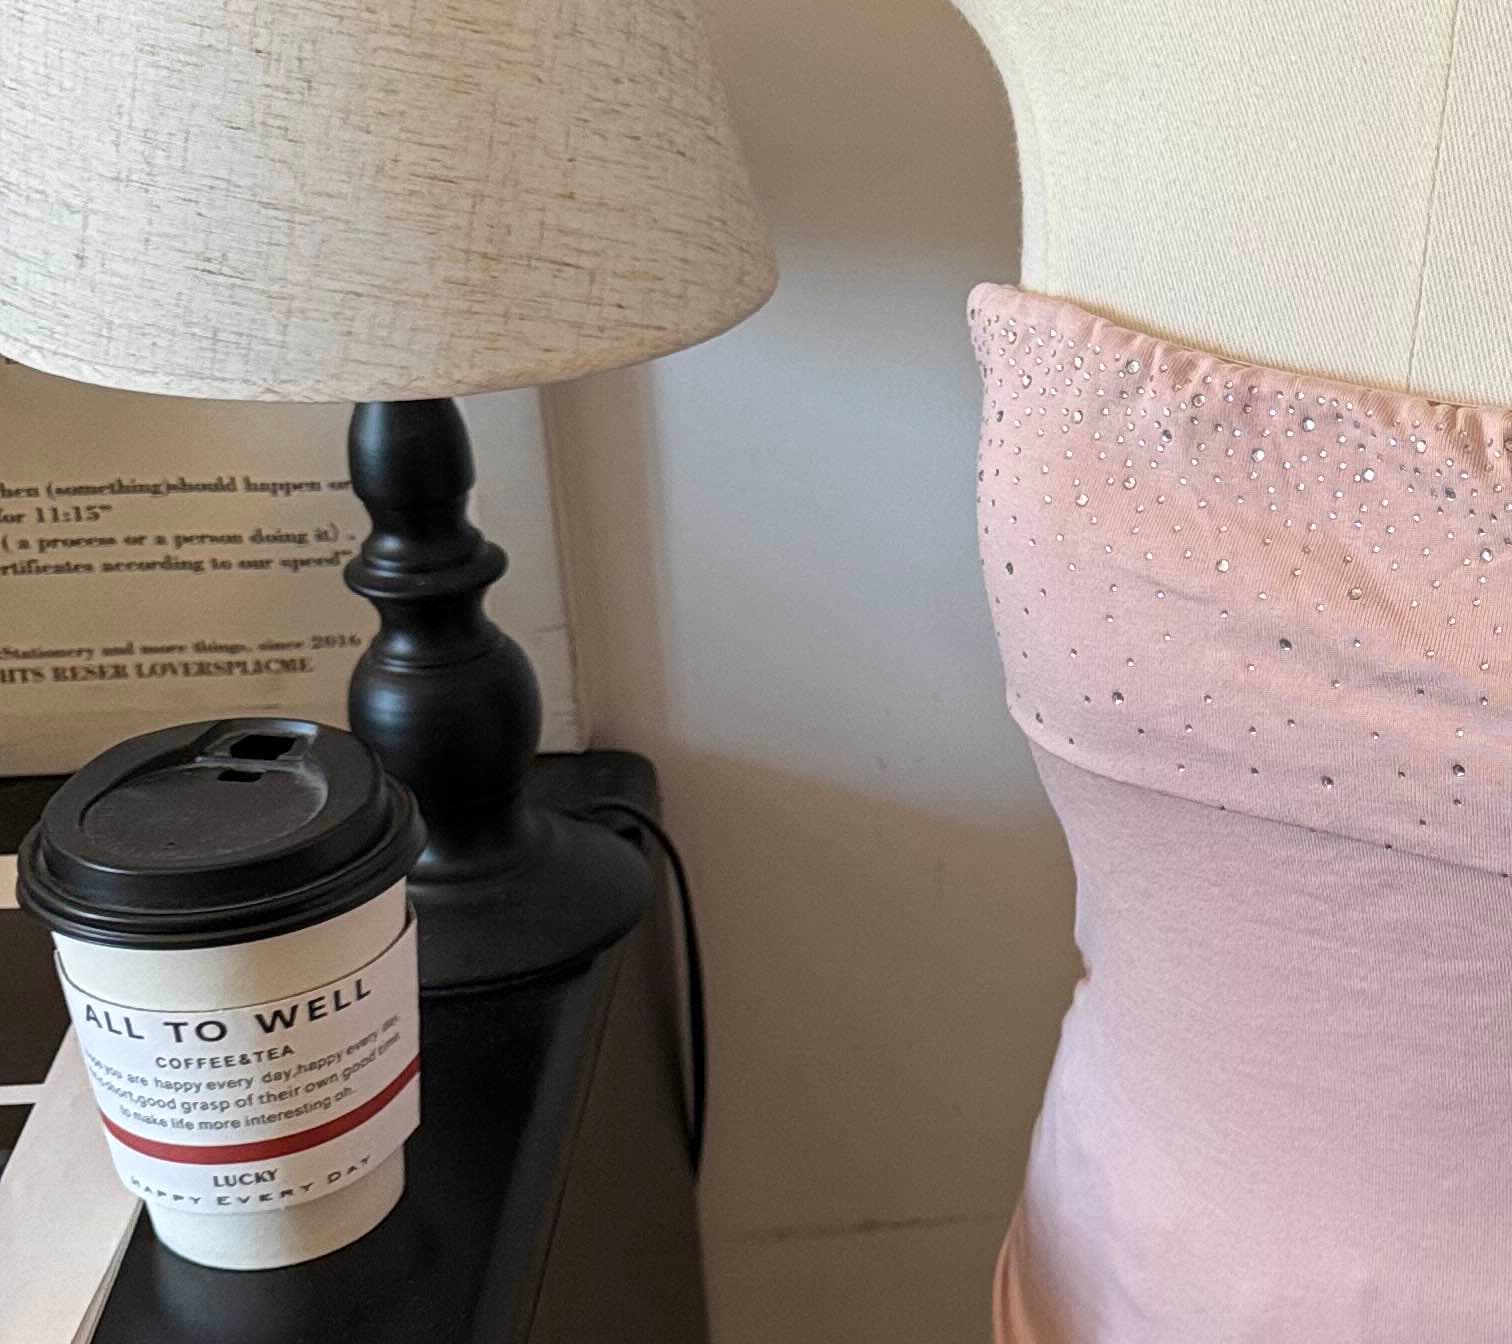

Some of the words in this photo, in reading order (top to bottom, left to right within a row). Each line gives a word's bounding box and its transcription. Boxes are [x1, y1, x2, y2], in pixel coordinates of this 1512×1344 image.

[243, 476, 321, 498] happen
[85, 1003, 145, 1040] ALL
[162, 1019, 229, 1044] TO
[254, 978, 372, 1035] WELL
[154, 1043, 296, 1070] COFFEE&TEA
[153, 1076, 202, 1094] happy
[205, 1076, 255, 1091] every
[179, 1098, 231, 1115] grasp
[234, 1092, 254, 1109] of
[257, 1083, 302, 1106] their
[304, 1071, 339, 1094] own
[170, 1117, 195, 1131] life
[198, 1118, 242, 1131] more
[245, 1096, 332, 1128] interesting
[212, 1168, 280, 1188] LUCKY
[216, 1181, 318, 1207] EVERY
